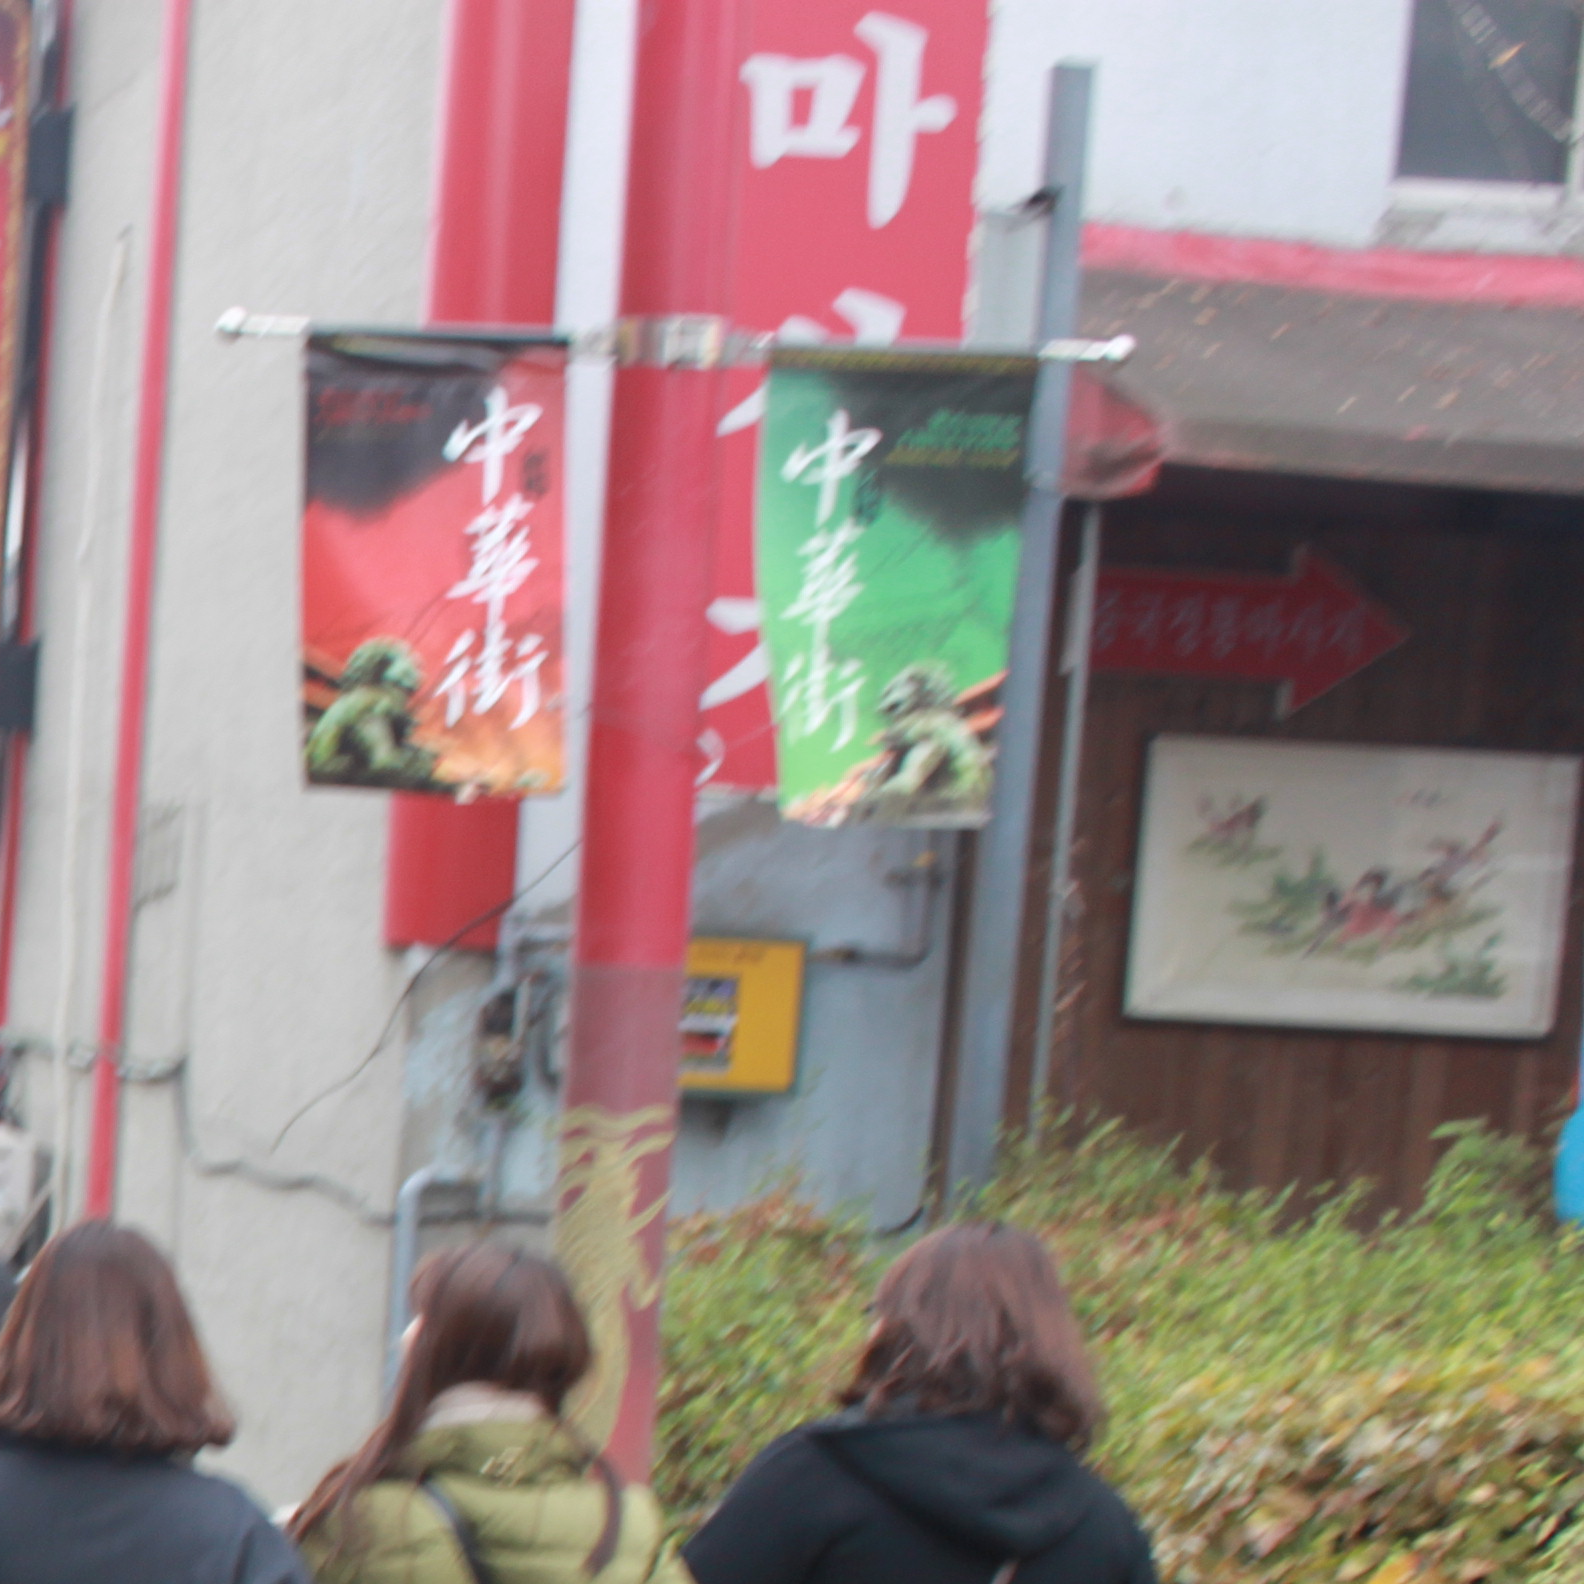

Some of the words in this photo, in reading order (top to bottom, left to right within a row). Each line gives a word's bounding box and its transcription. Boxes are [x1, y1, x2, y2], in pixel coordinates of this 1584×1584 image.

[434, 383, 549, 732] 中華街
[778, 408, 883, 754] 中華街
